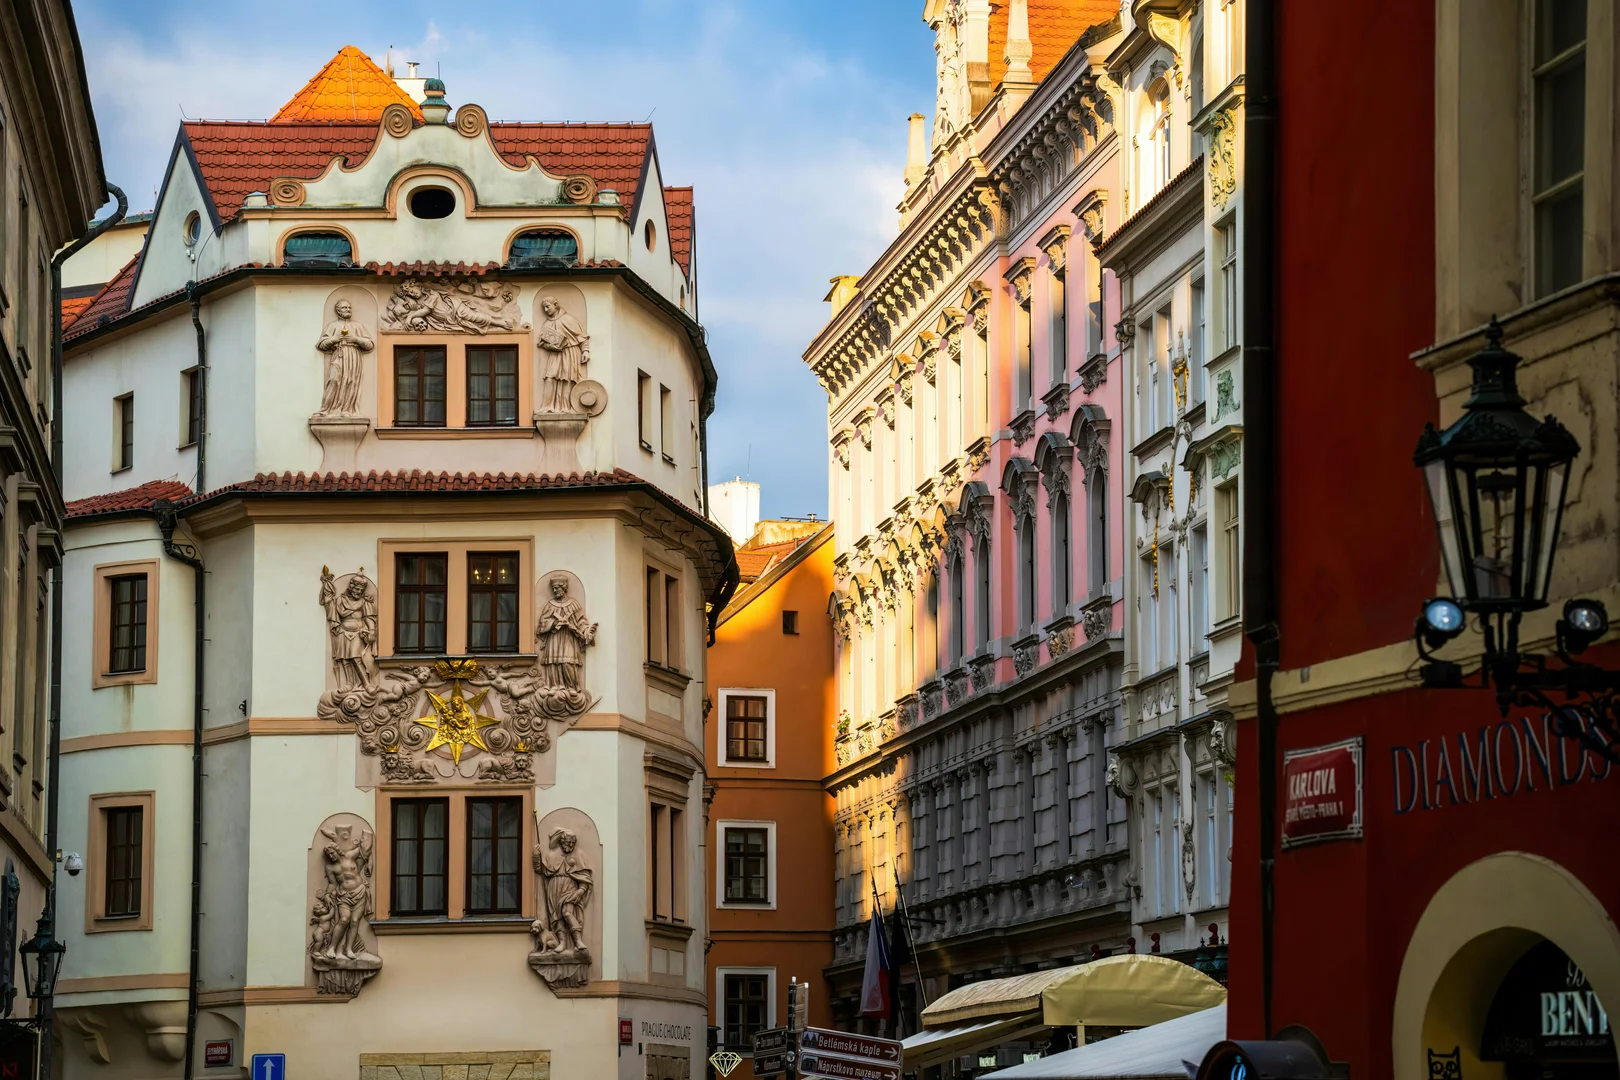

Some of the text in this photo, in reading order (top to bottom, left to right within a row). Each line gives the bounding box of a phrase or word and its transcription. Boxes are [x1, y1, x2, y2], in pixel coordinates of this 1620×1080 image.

[1390, 707, 1612, 815] DIAMONDS
[1289, 767, 1336, 801] KARLOVA
[1339, 800, 1344, 815] 1
[641, 1021, 663, 1038] PRAGUE
[663, 1023, 691, 1041] CHOCOLATE
[818, 1035, 881, 1057] Betlémská kaple
[817, 1059, 882, 1079] Náprstkovo muzeum
